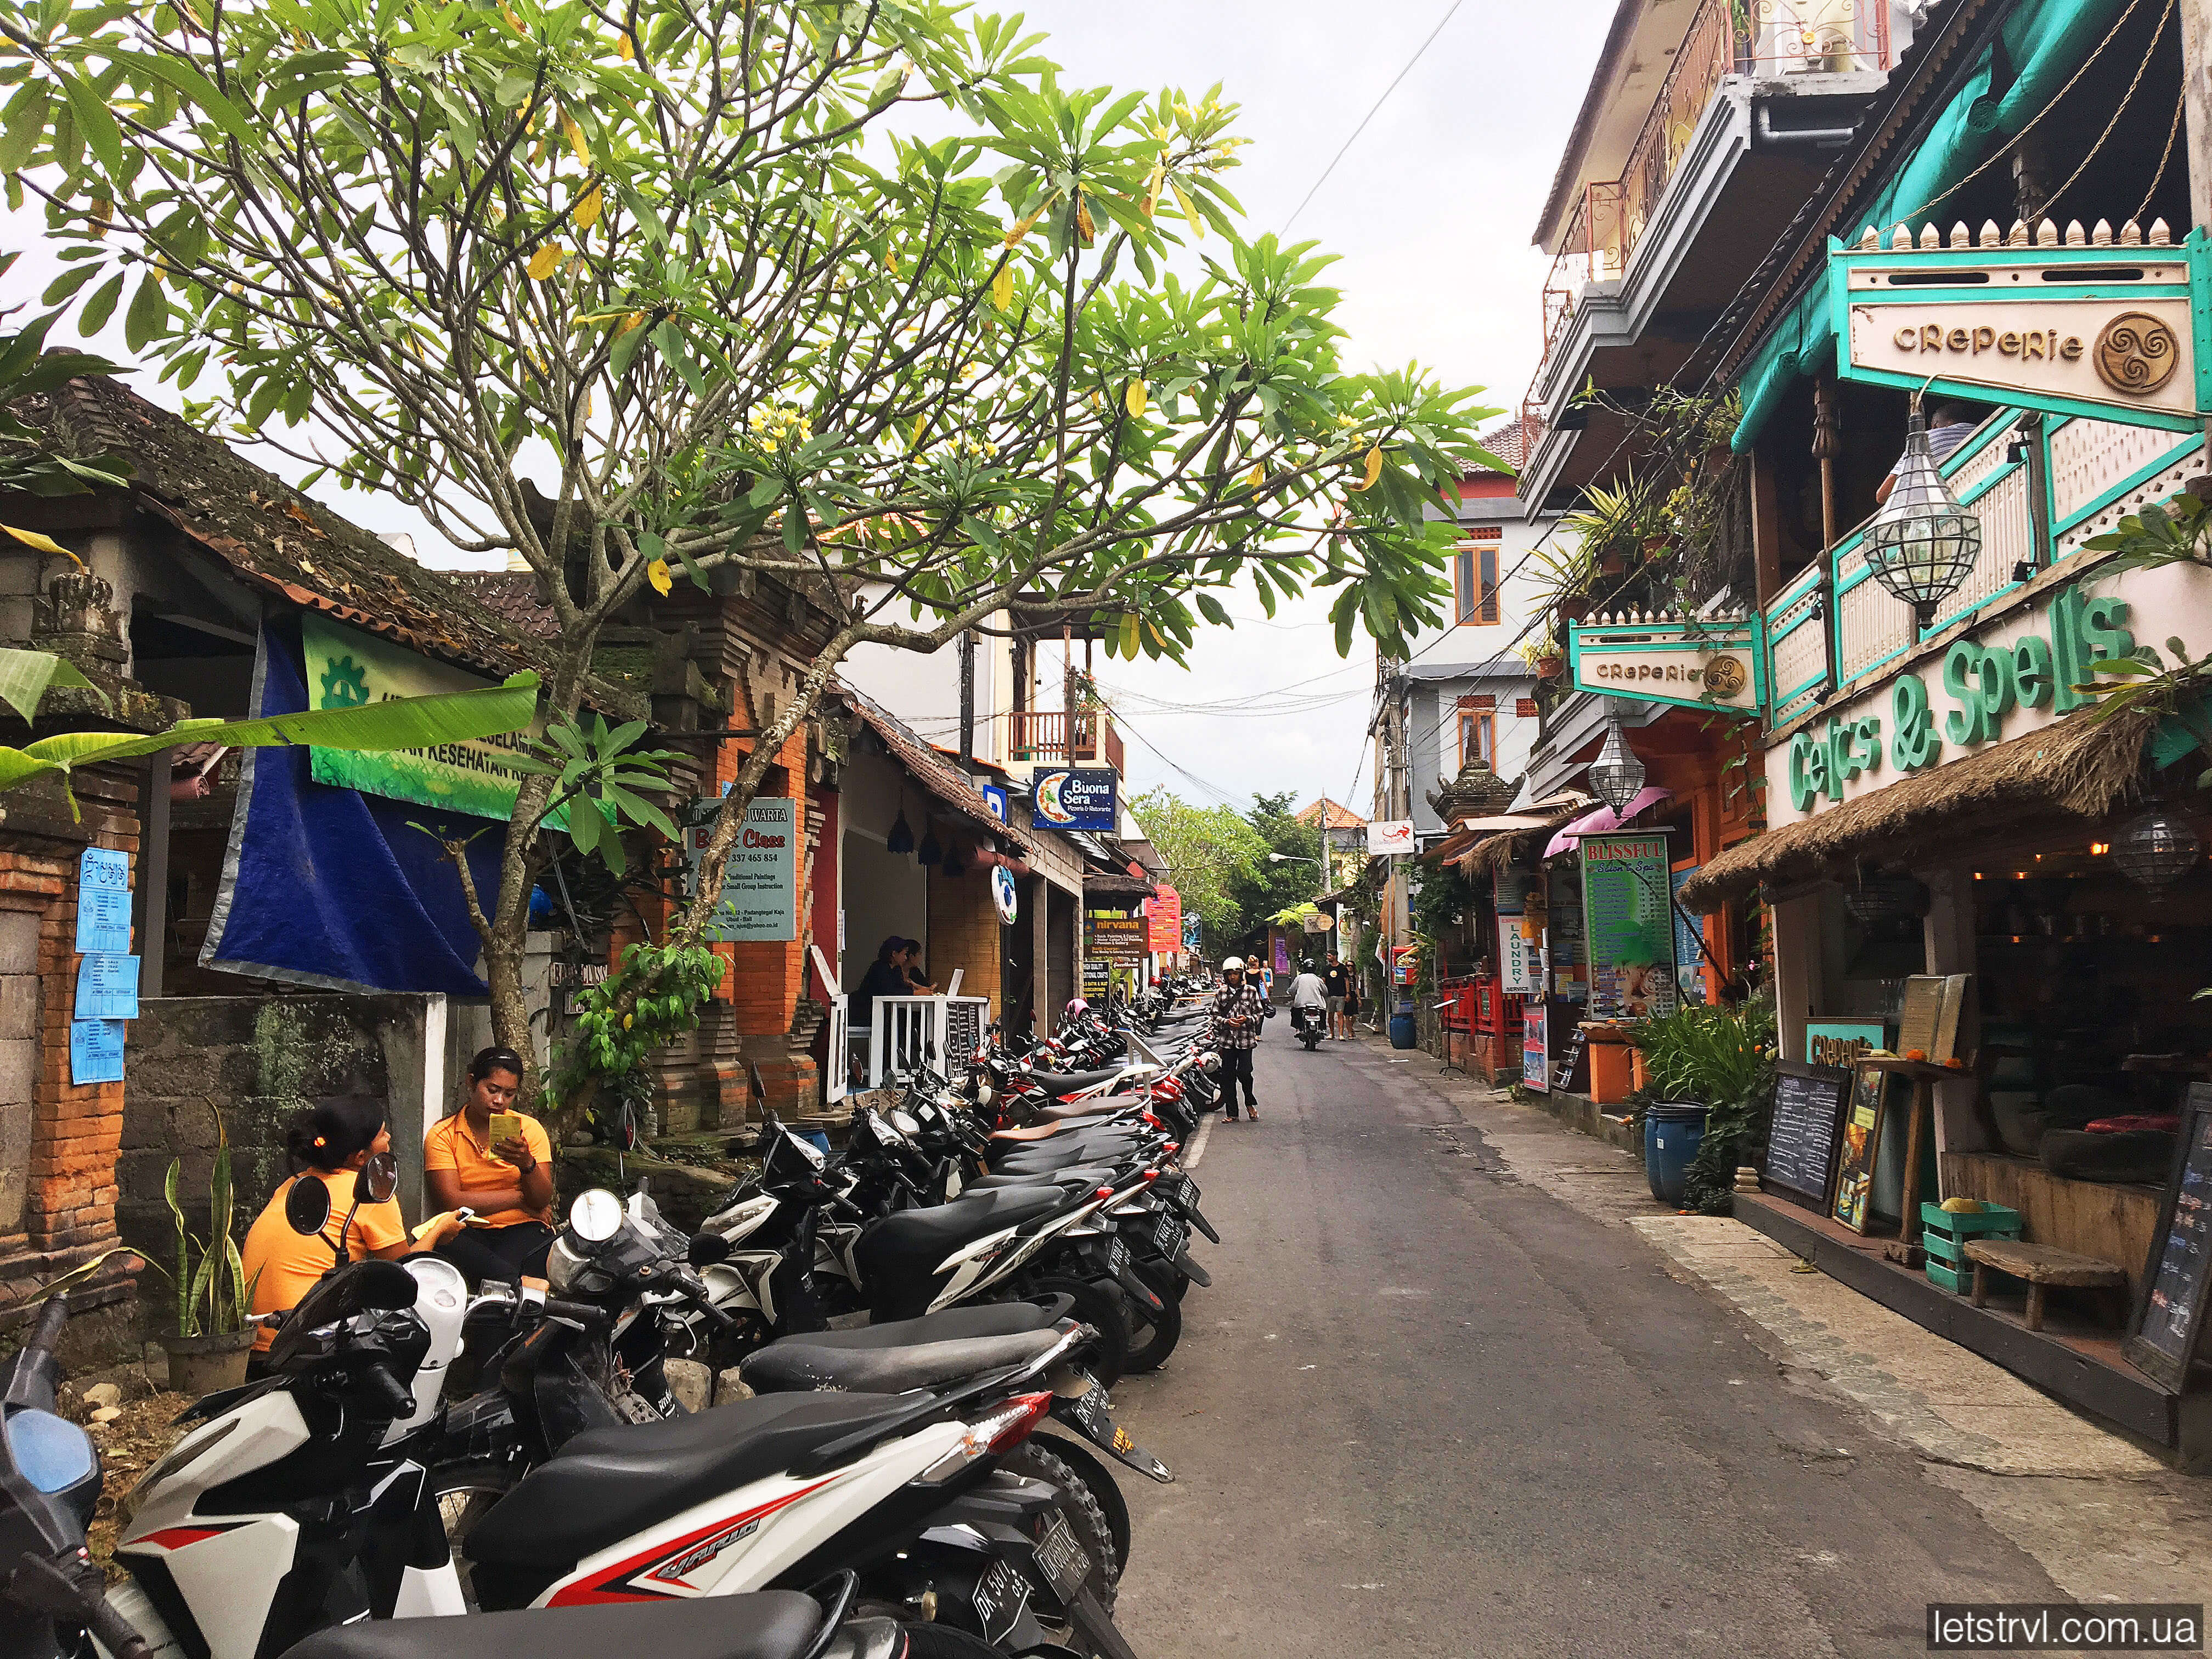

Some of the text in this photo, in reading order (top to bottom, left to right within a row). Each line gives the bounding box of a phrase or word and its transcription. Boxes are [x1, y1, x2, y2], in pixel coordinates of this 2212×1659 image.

[1789, 583, 2135, 812] Celts & Spells
[1072, 780, 1109, 794] Buona
[1063, 789, 1090, 804] Sera
[750, 808, 788, 822] WARTA
[743, 828, 786, 849] Class
[731, 854, 778, 862] 337 465 854
[1587, 842, 1663, 861] BLISSFUL
[1635, 860, 1656, 874] Spa
[1097, 921, 1139, 929] nirvana
[1510, 923, 1522, 985] LAUNDRY
[977, 1587, 997, 1621] DK
